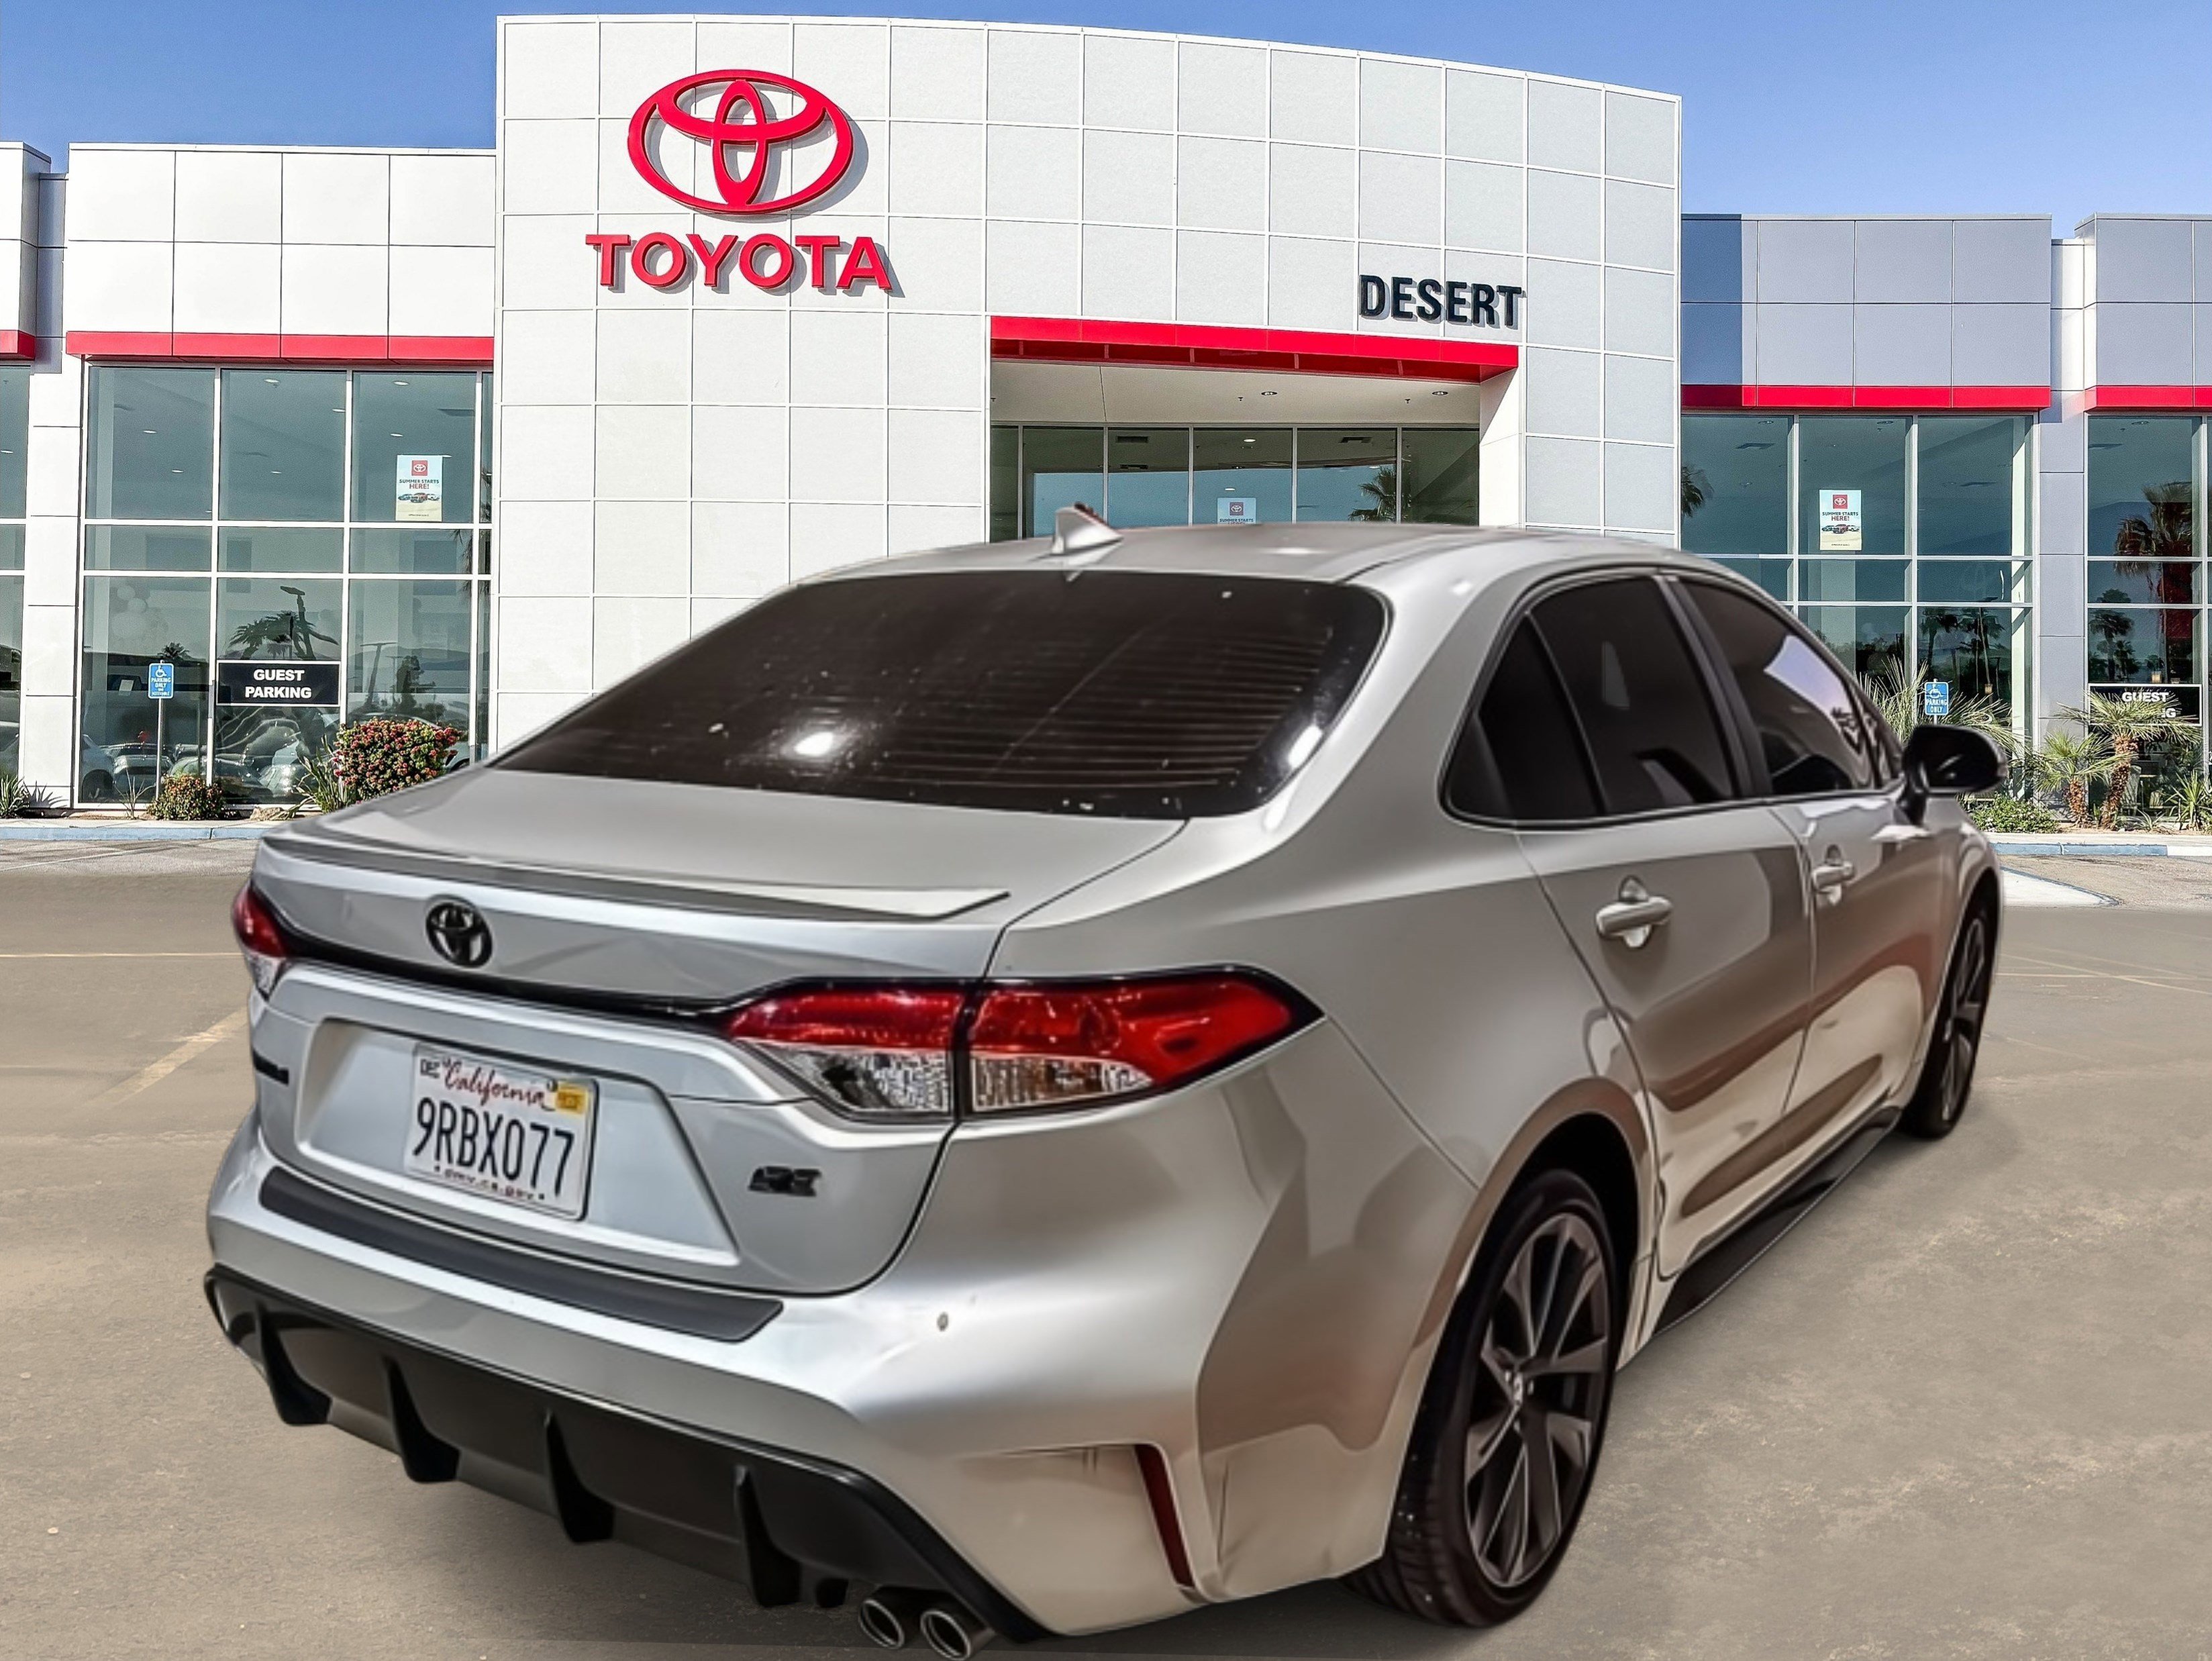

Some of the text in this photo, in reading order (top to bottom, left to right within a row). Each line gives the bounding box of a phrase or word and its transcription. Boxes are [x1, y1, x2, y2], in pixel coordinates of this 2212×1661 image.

[585, 232, 893, 291] TOYOTA
[1359, 274, 1522, 326] DESERT
[245, 686, 312, 699] PARKING
[253, 668, 305, 681] GUEST
[2121, 691, 2169, 703] GUEST
[442, 1058, 556, 1111] California
[413, 1097, 574, 1197] 9RBX077
